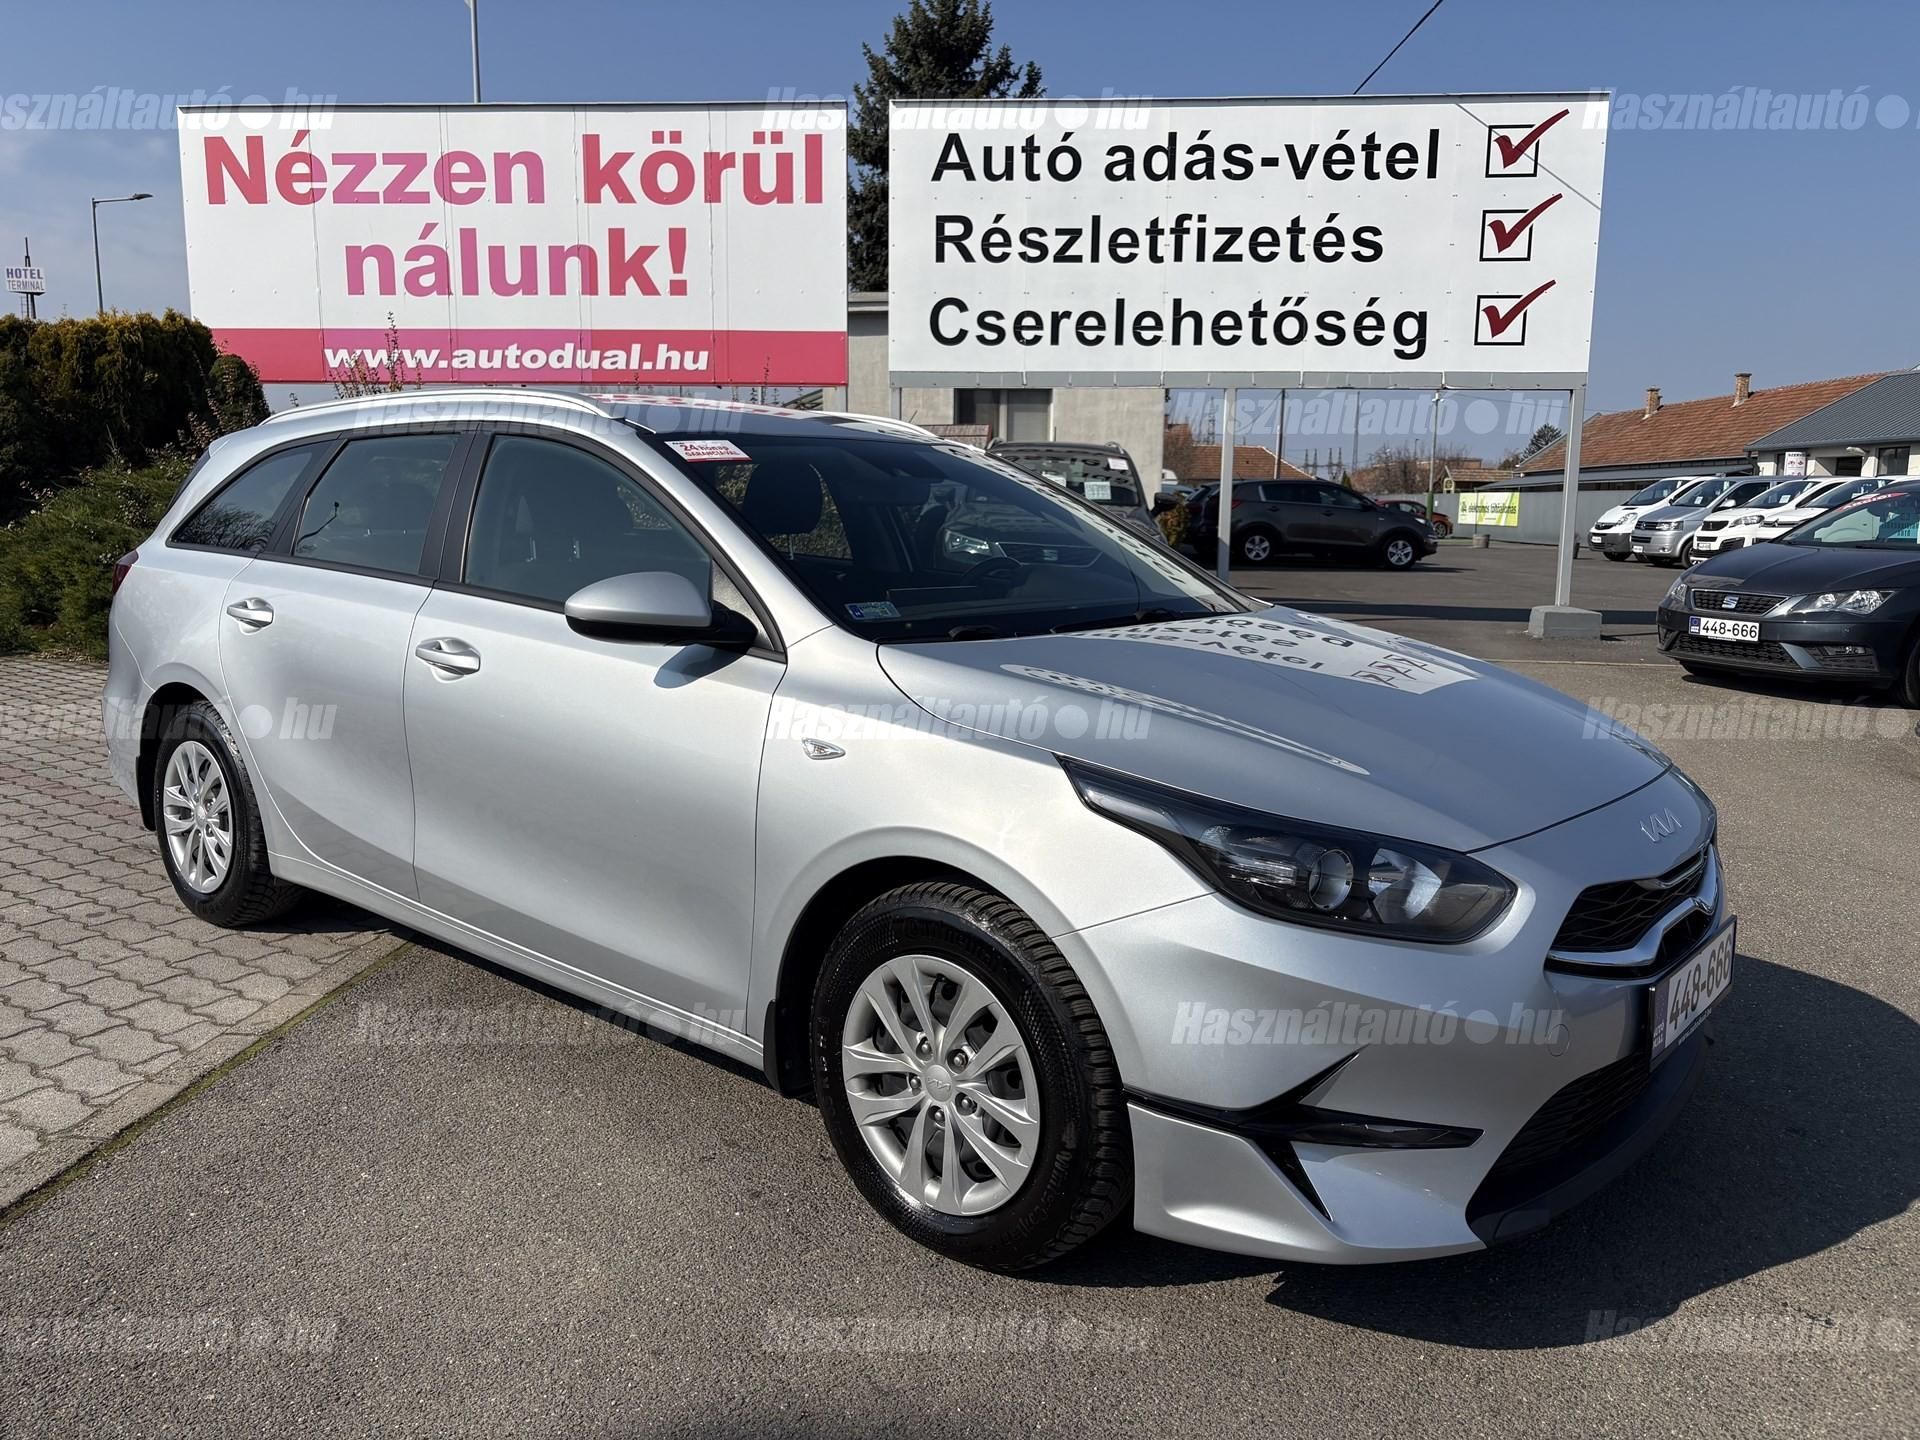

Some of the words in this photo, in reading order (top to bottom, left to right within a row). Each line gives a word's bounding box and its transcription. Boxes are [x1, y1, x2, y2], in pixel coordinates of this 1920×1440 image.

[203, 130, 545, 206] Nézzen
[582, 130, 823, 205] körül
[931, 131, 1083, 182] Autó
[1104, 128, 1439, 182] adás-vétel
[345, 222, 688, 297] nálunk!
[935, 213, 1384, 264] Részletfizetés
[6, 267, 44, 280] HOTEL
[7, 279, 45, 291] TERMINAL
[929, 297, 1429, 360] Cserelehetőség
[323, 342, 710, 371] www.autodual.hu
[1702, 620, 1758, 639] 448-666
[1668, 933, 1732, 1031] 448-666
